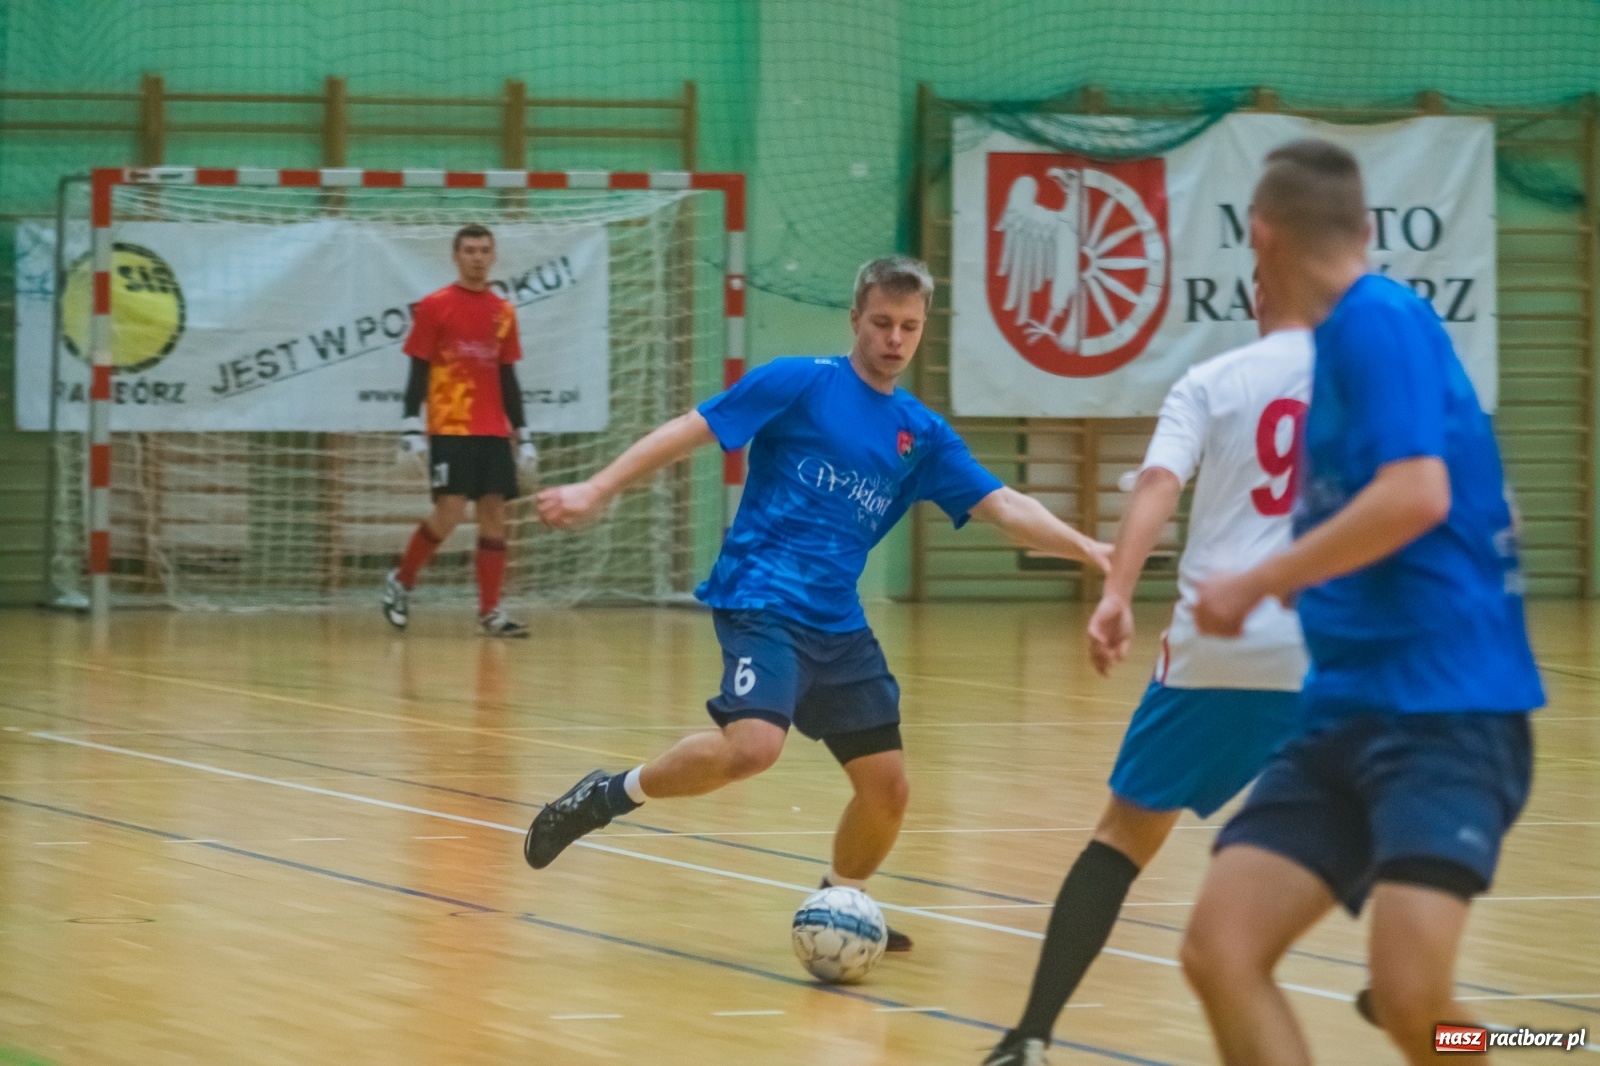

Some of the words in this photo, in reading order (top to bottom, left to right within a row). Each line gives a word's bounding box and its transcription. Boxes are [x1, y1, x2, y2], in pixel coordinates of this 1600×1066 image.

[1218, 204, 1442, 251] MTO
[1183, 264, 1477, 323] RARZ
[211, 339, 299, 394] JEST
[308, 325, 346, 360] W
[355, 257, 577, 348] POKU!
[1251, 397, 1309, 517] 9
[734, 657, 756, 696] 6
